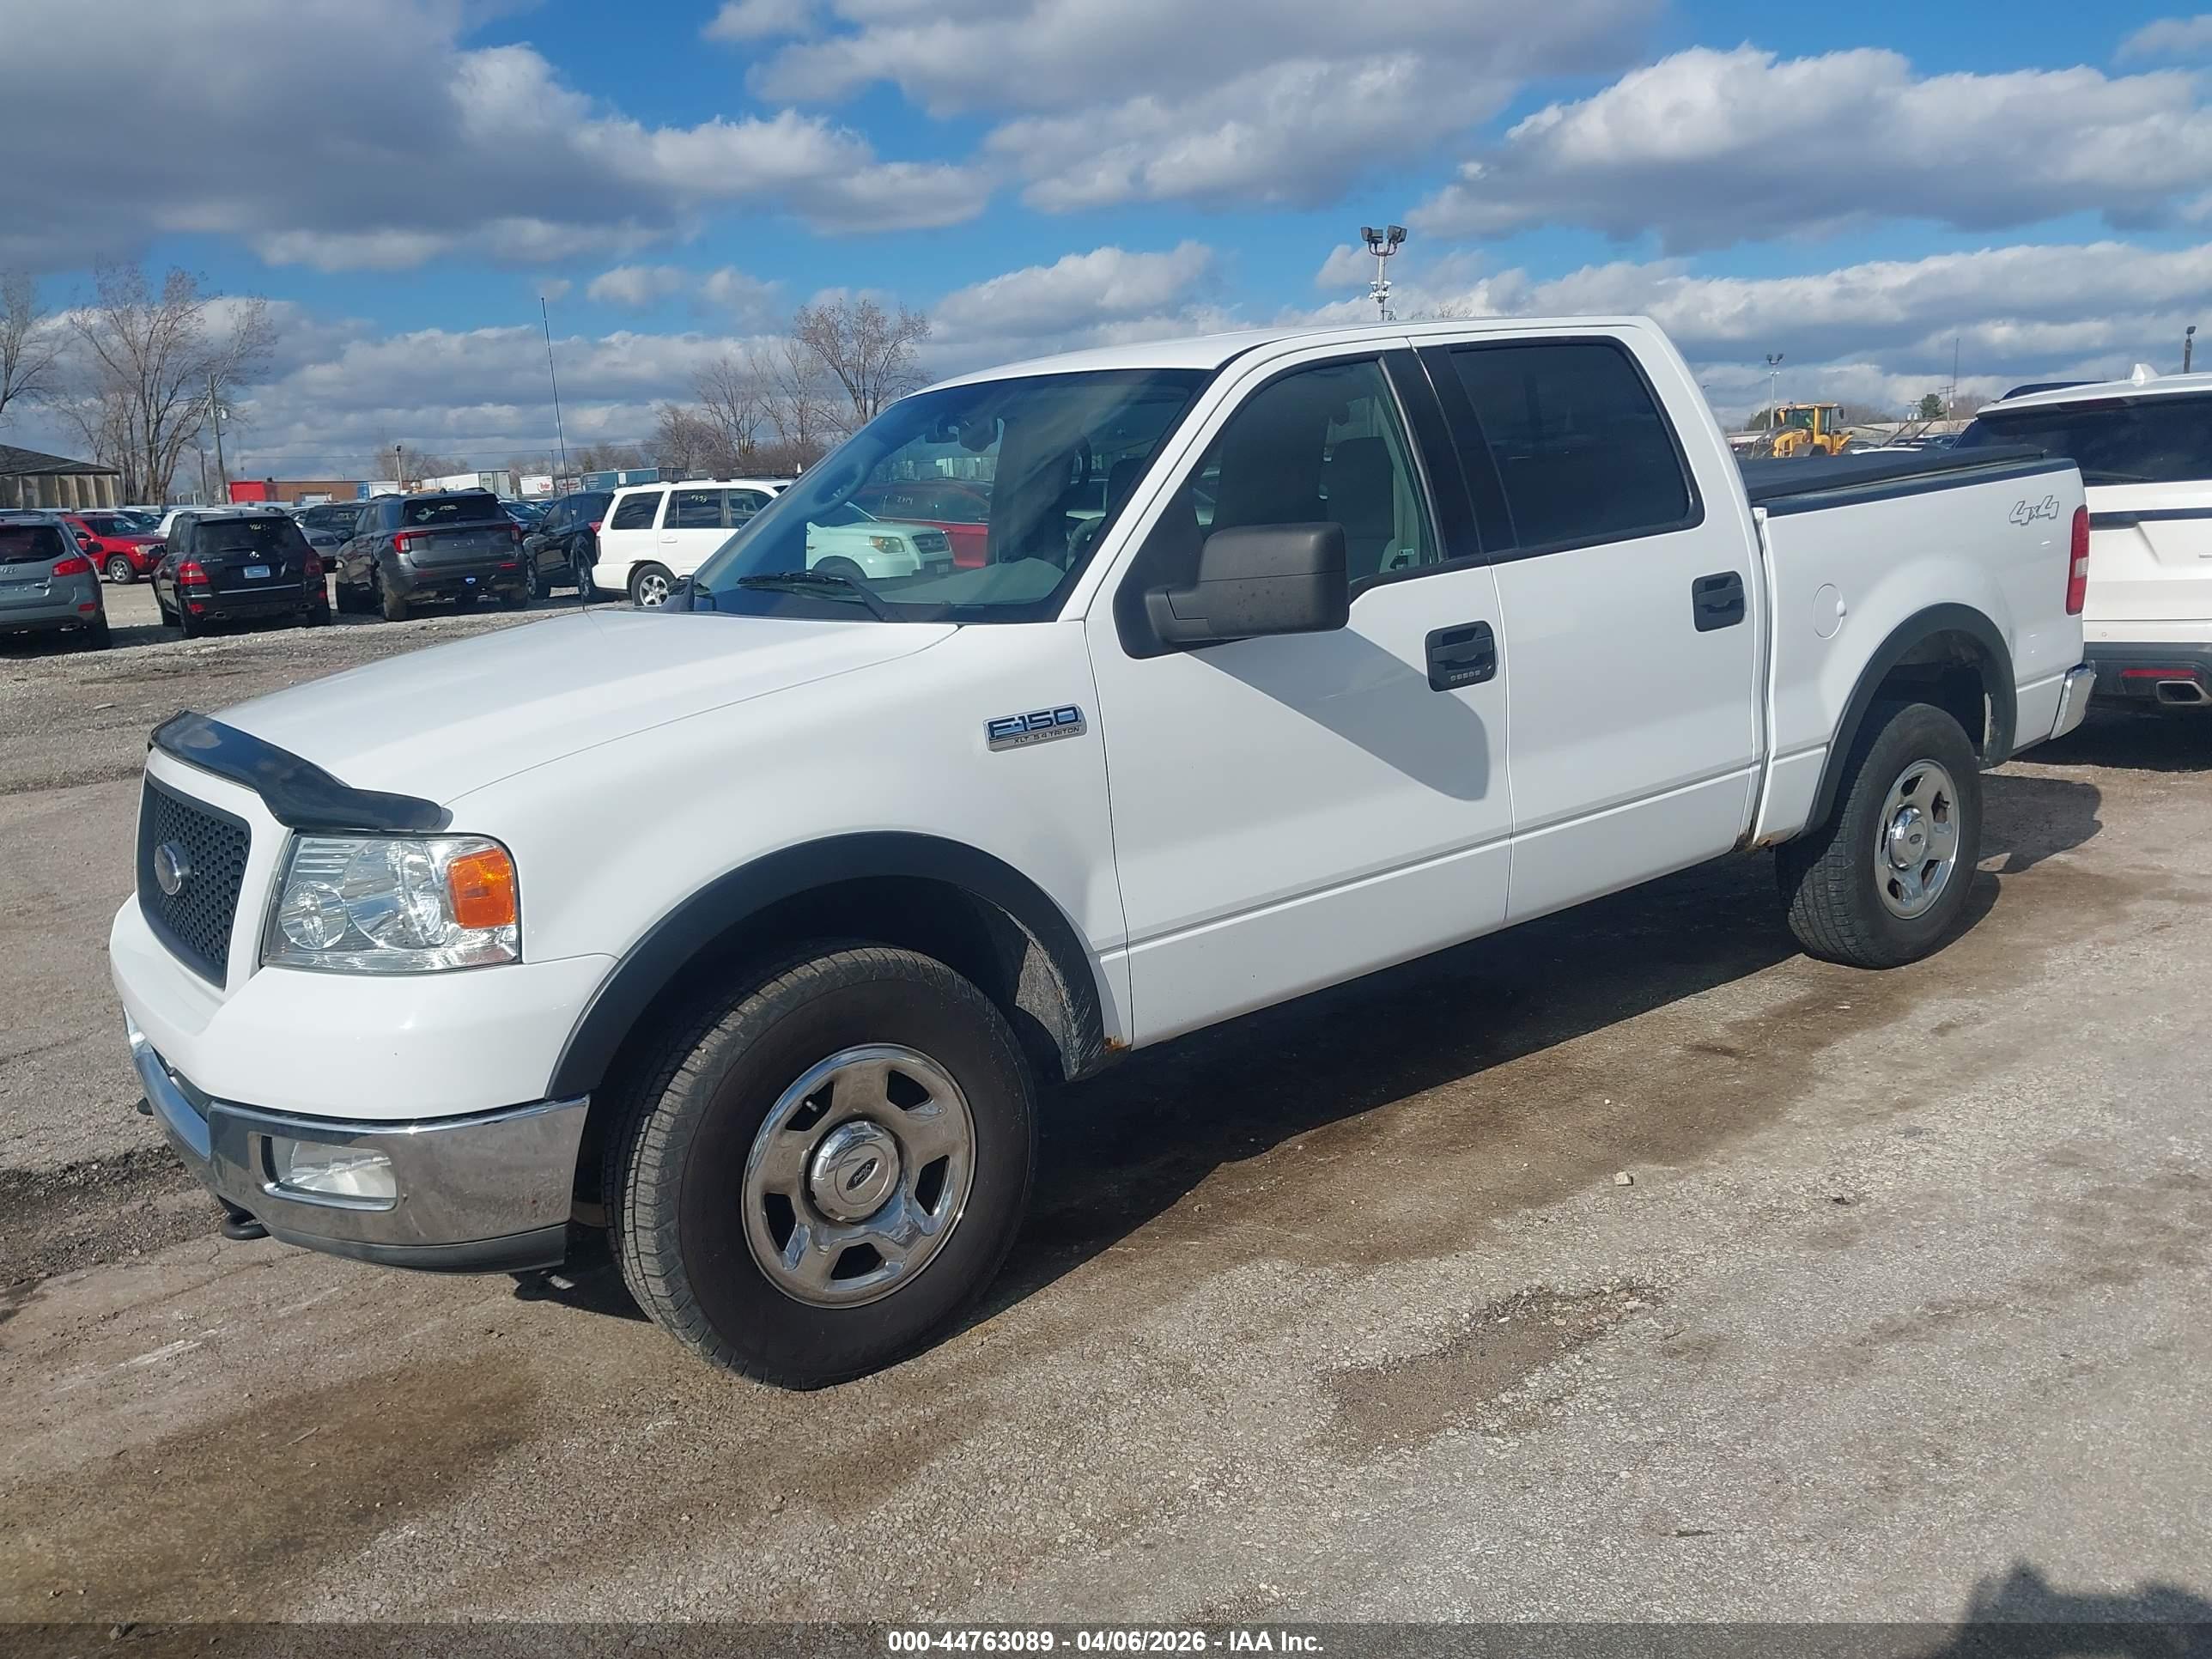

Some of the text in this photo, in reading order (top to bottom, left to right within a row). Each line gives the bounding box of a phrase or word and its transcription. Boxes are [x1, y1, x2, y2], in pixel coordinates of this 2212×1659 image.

[2009, 495, 2059, 526] 4x4
[988, 706, 1079, 738] F-150
[1013, 736, 1030, 744] XLT
[1048, 727, 1080, 738] TRITON
